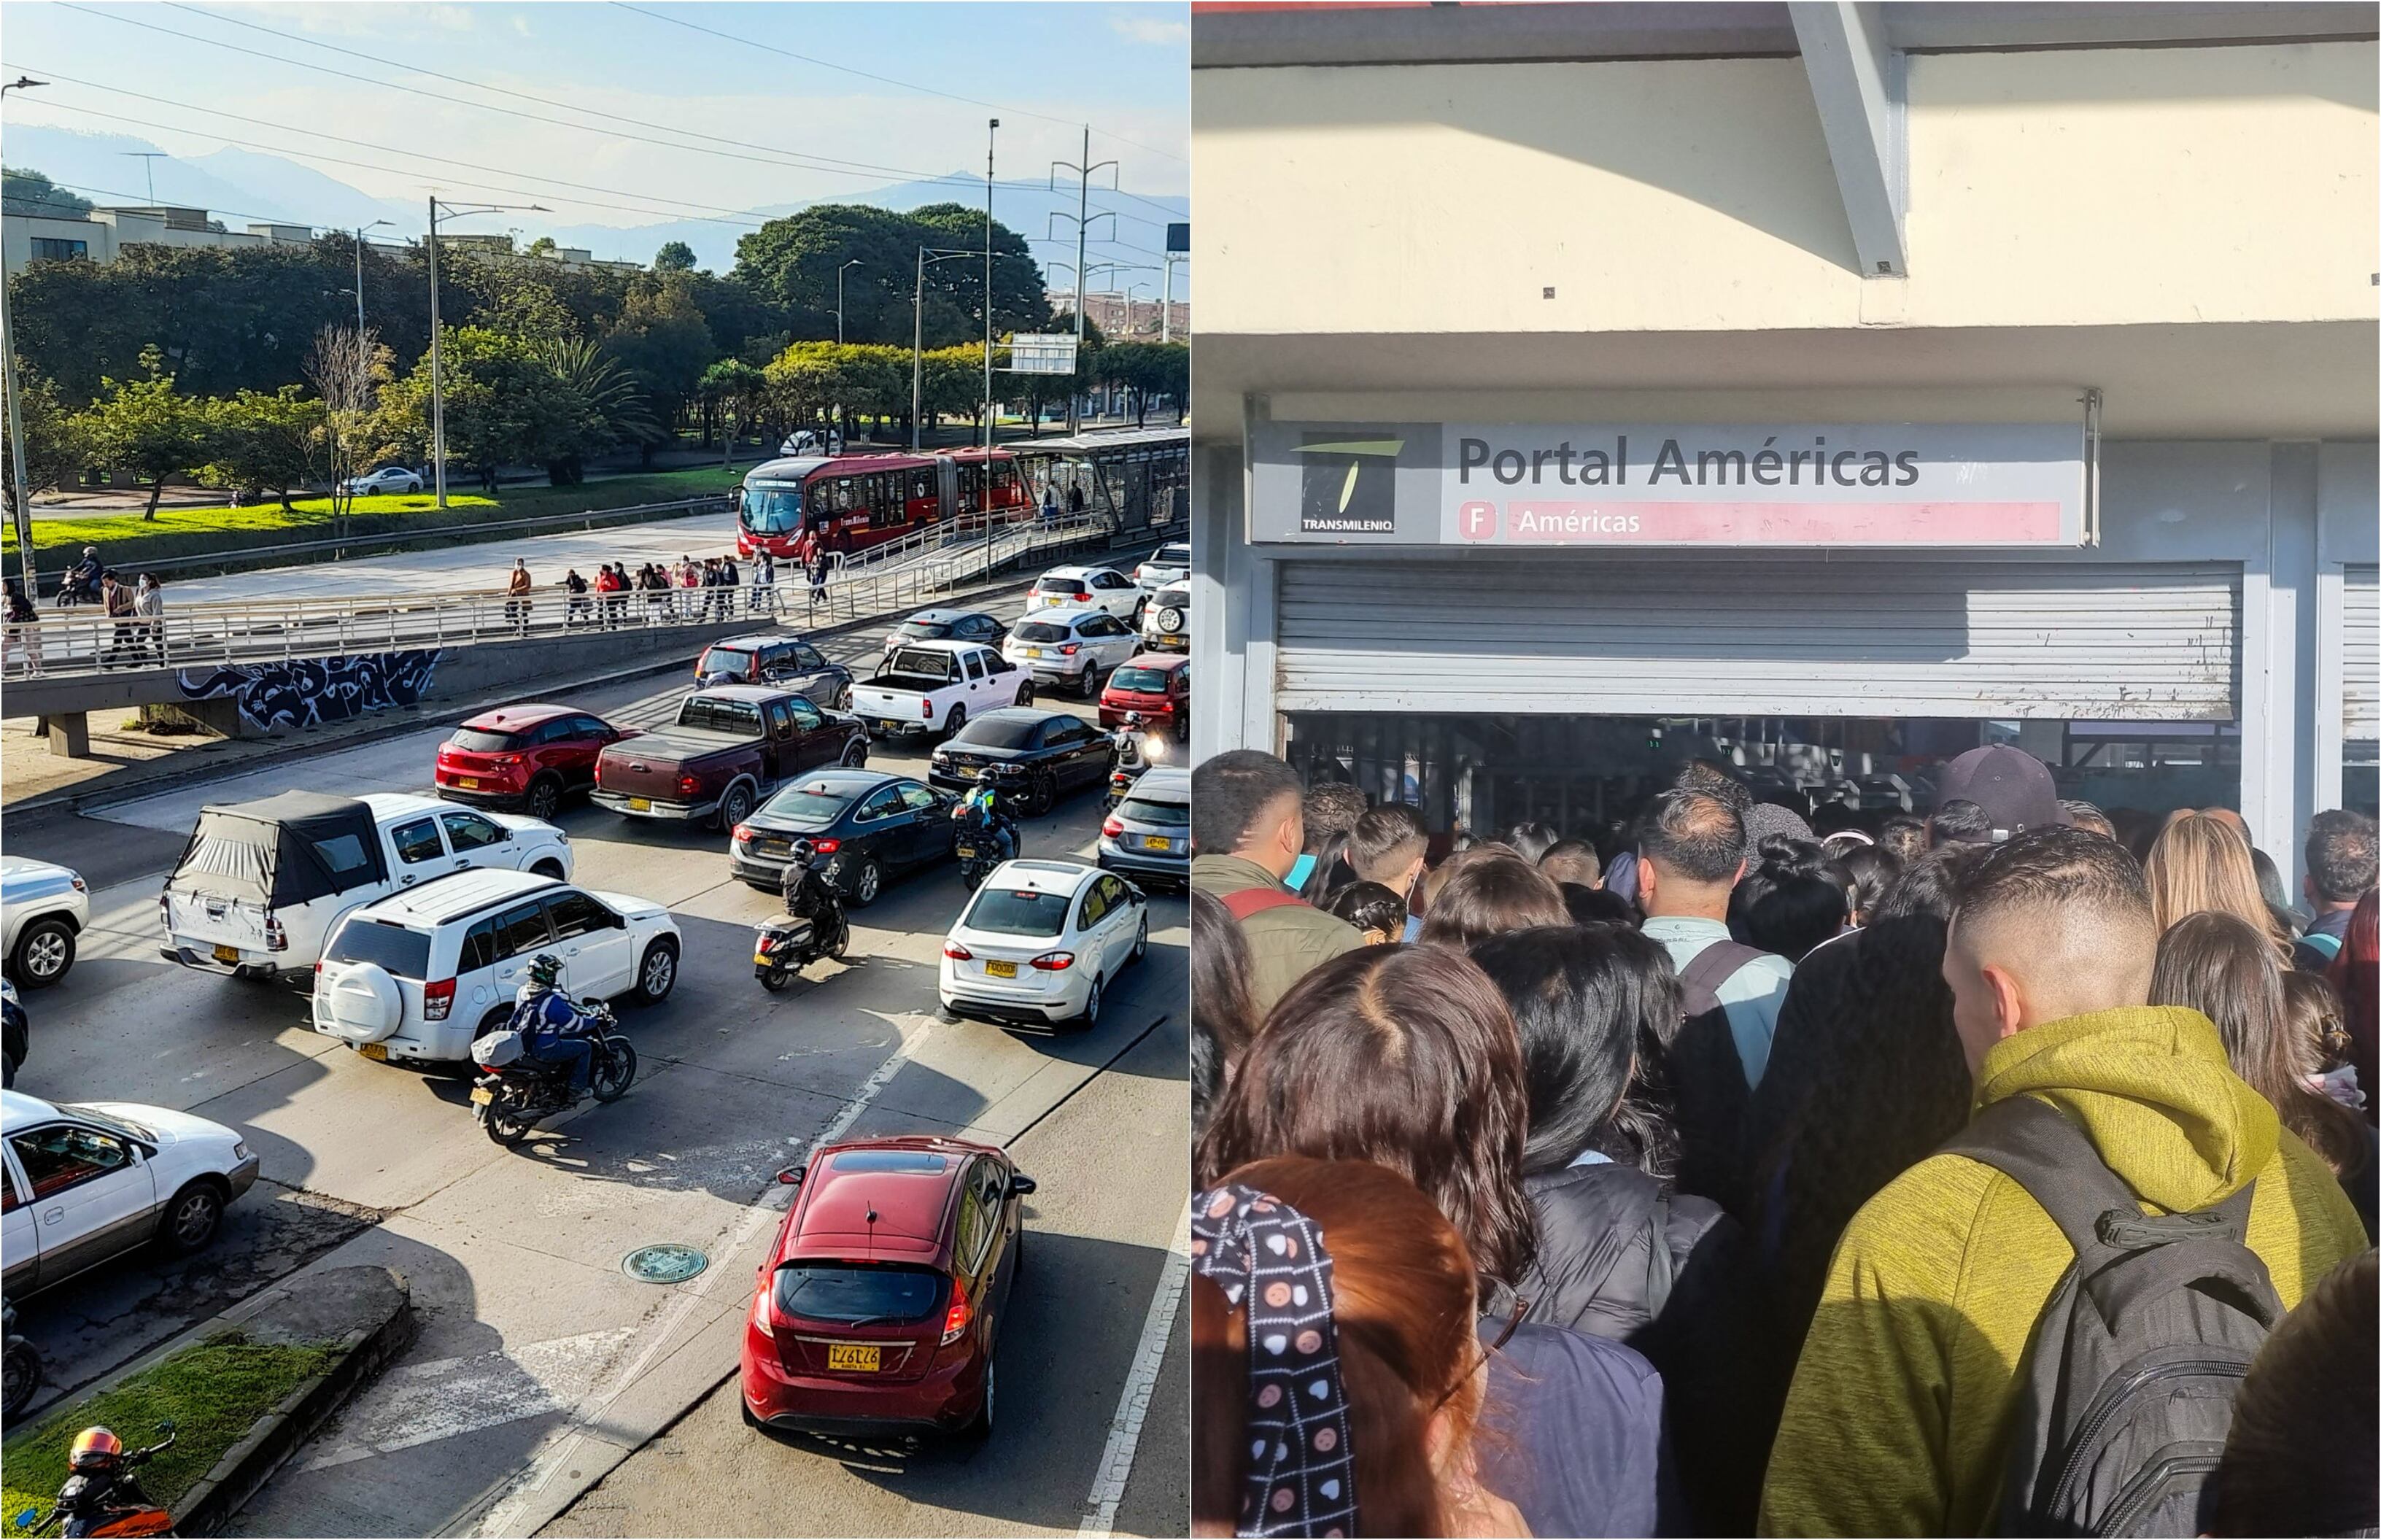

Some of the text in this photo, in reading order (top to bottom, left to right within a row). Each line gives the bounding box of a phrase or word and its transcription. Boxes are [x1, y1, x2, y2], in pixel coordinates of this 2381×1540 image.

[1460, 436, 1920, 487] Portal Américas
[1303, 519, 1393, 531] TRANSMILENIO
[1469, 508, 1641, 533] F Américas
